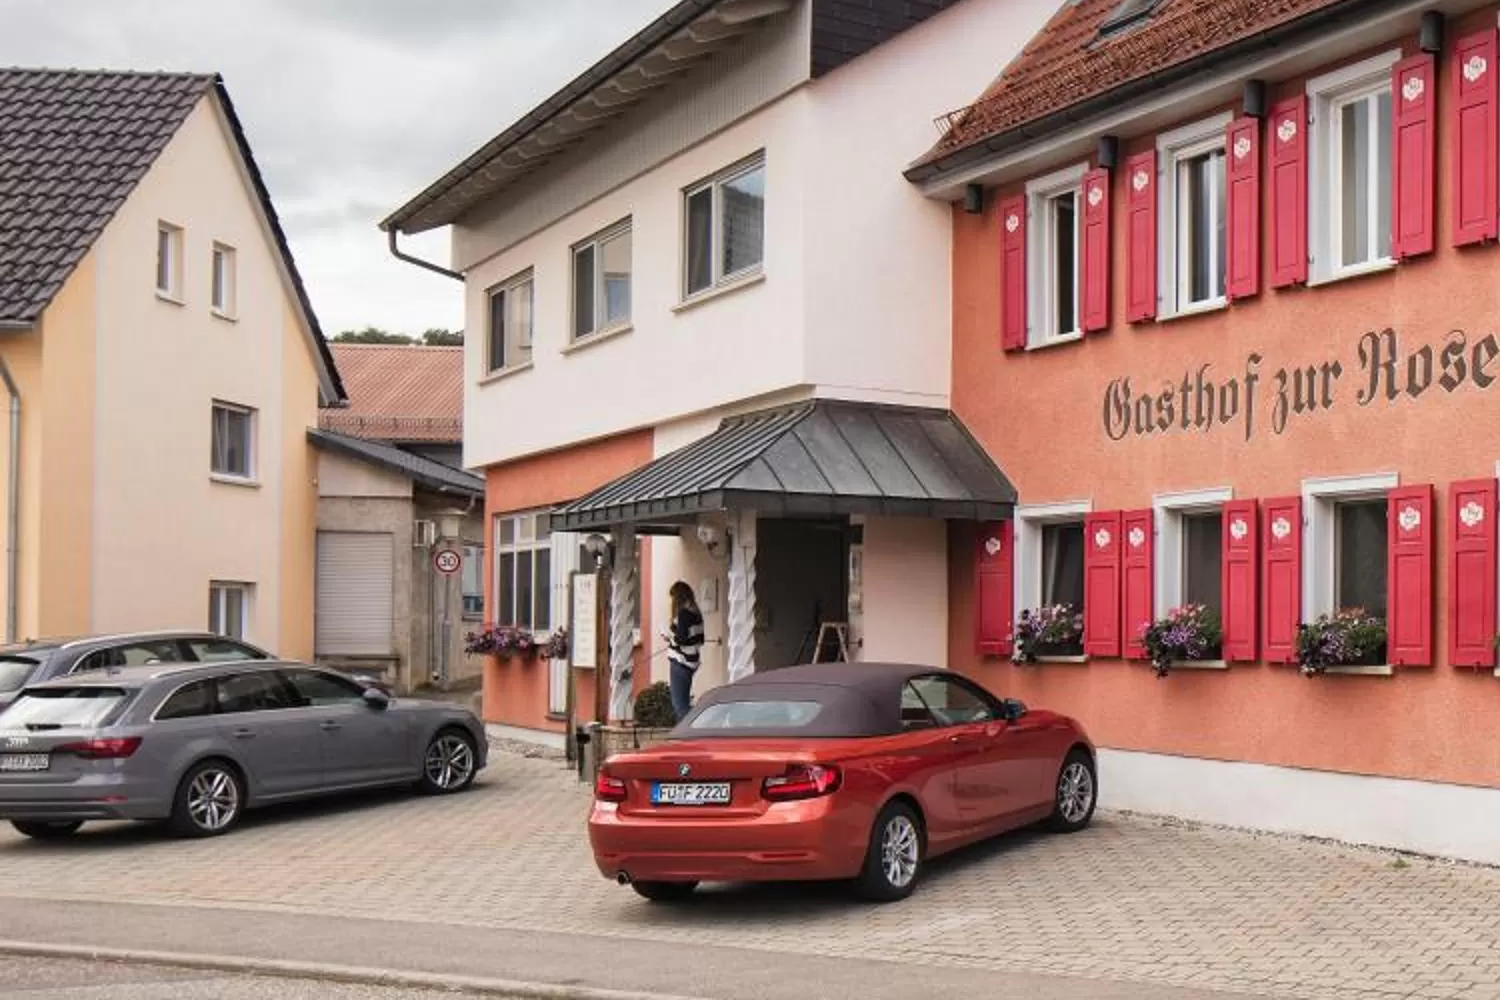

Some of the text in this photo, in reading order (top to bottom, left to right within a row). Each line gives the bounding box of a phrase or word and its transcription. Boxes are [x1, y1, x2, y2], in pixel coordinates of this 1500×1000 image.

[1102, 326, 1500, 441] Gasthof zur Rose
[441, 555, 457, 567] 30
